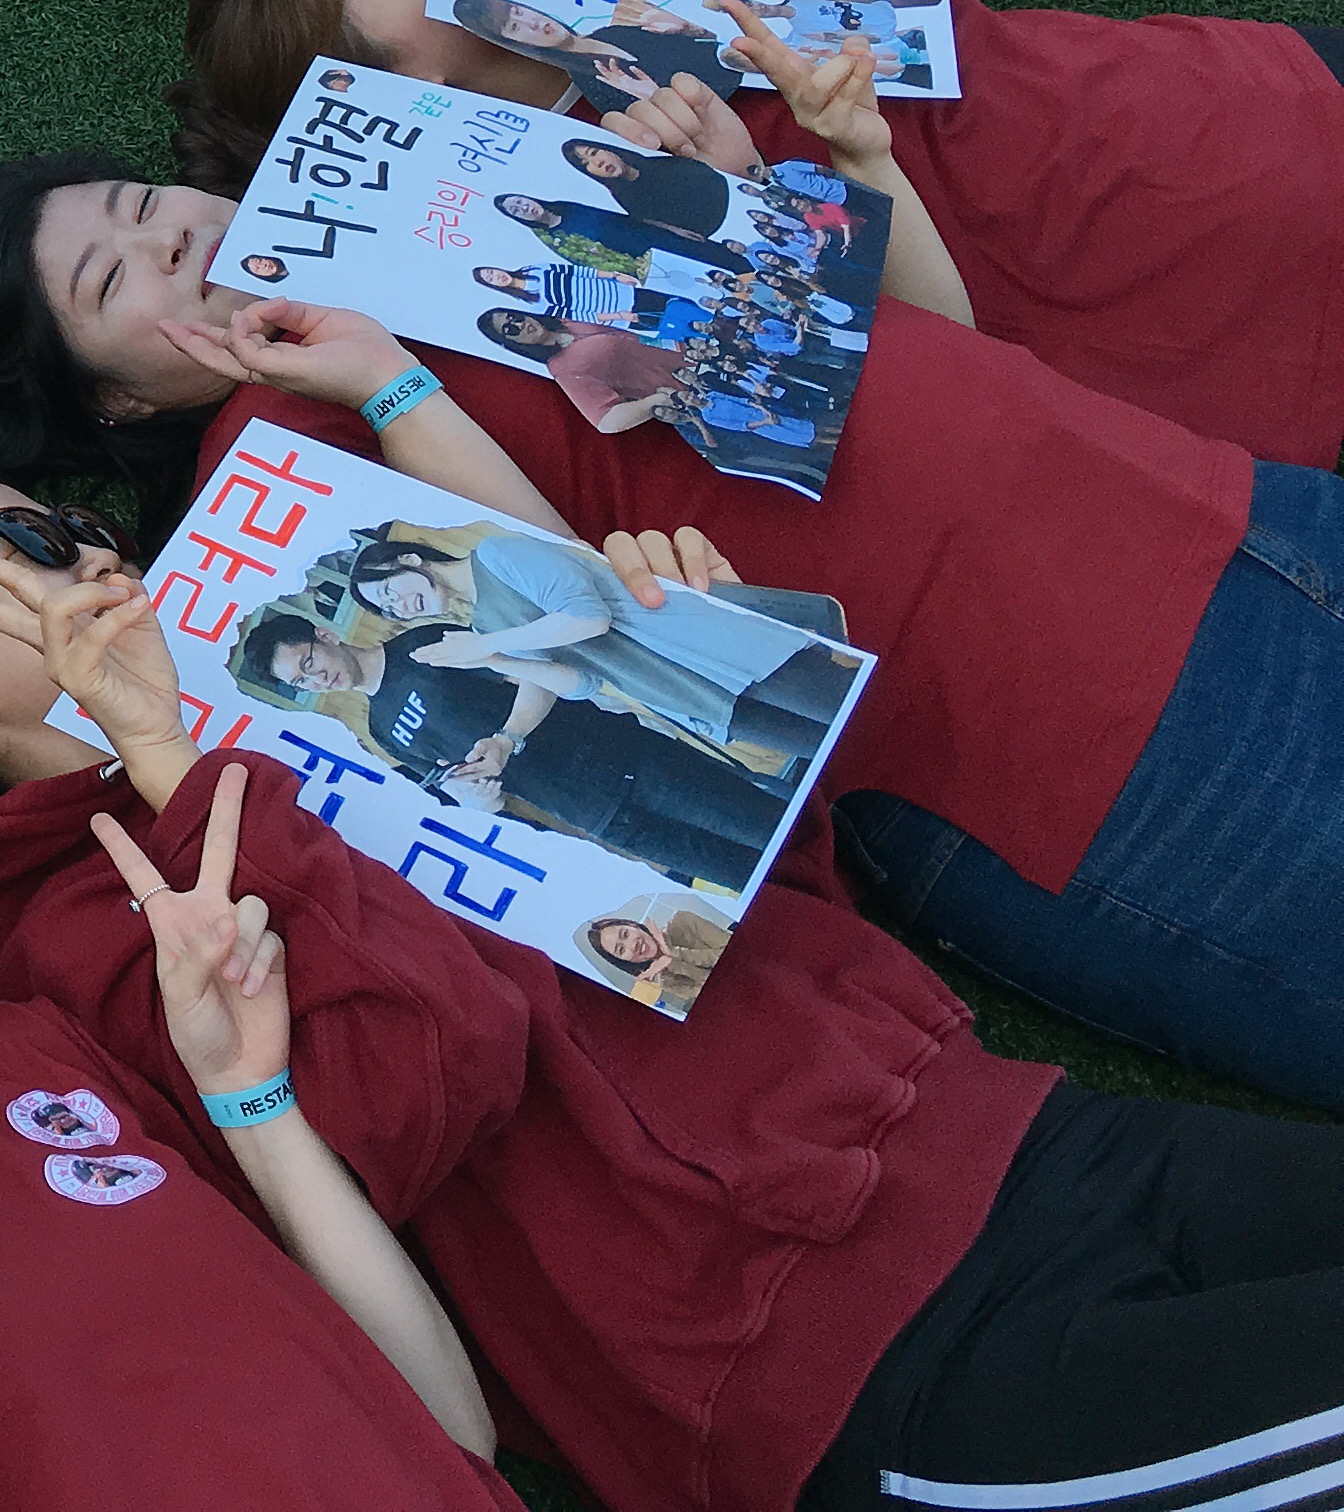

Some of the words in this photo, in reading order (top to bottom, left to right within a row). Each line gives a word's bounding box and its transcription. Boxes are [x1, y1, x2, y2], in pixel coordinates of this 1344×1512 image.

[448, 120, 523, 176] 여신
[412, 179, 485, 252] 승리의
[373, 375, 427, 420] RESTART
[392, 690, 430, 747] HUF
